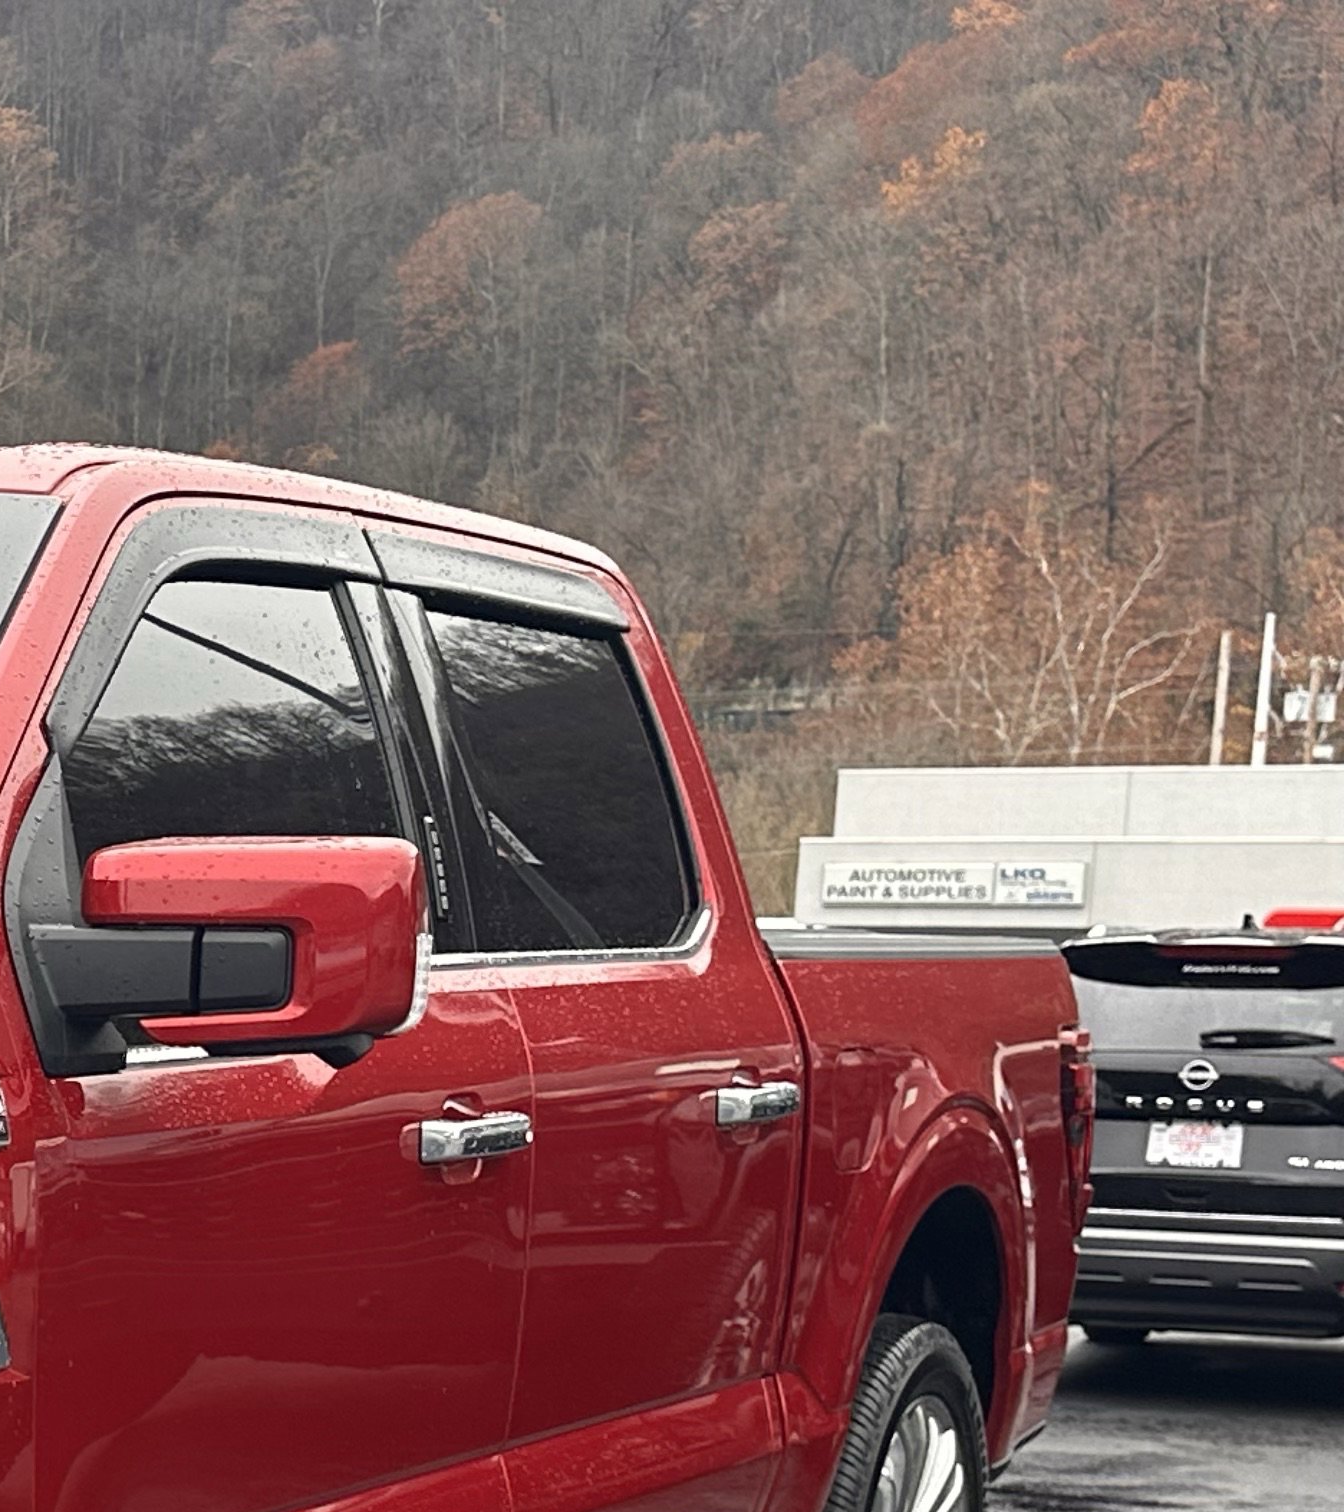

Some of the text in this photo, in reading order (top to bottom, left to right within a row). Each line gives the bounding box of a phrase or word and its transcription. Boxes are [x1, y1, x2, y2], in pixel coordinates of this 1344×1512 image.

[848, 868, 967, 883] AUTOMOTIVE
[826, 884, 987, 899] PAINT & SUPPLIES
